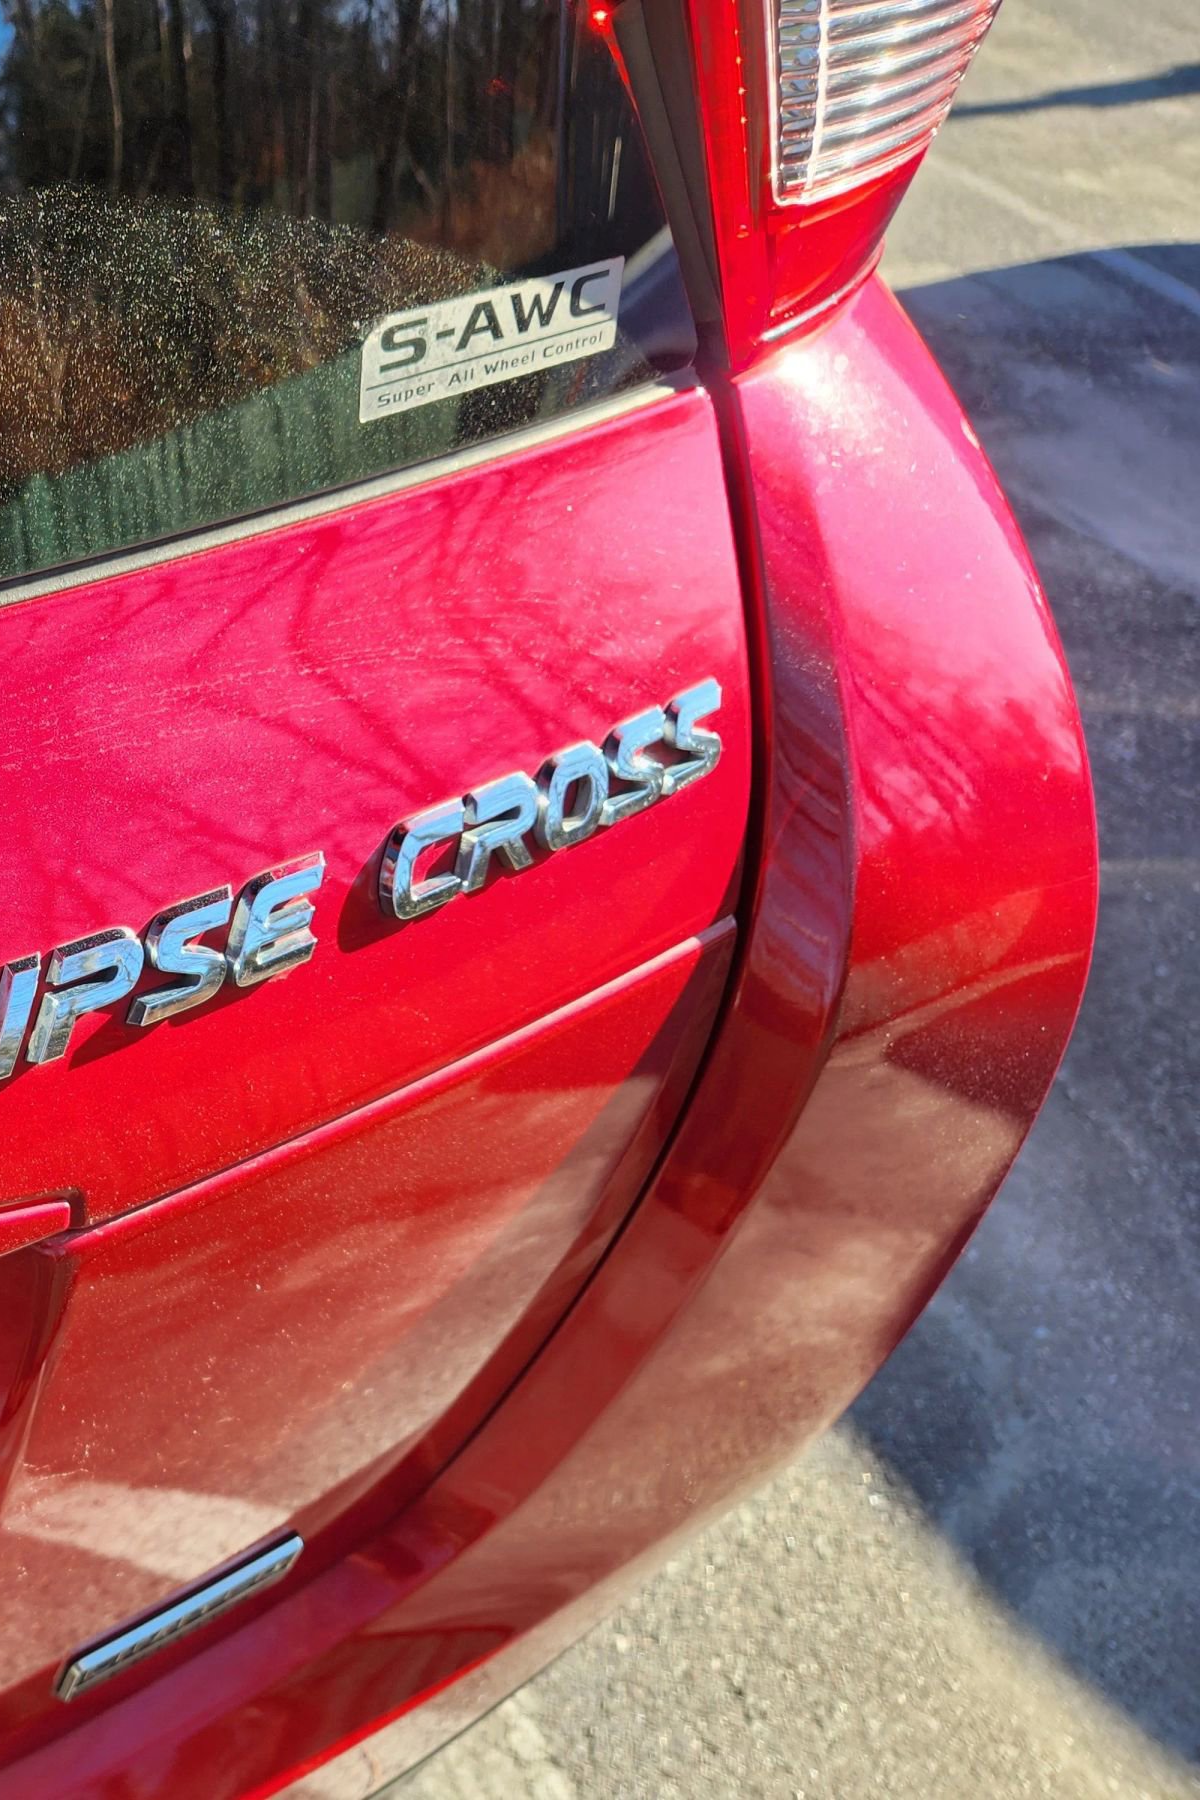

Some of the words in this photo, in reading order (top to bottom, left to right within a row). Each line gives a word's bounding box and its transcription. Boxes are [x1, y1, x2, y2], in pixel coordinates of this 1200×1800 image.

[376, 379, 436, 409] Super
[447, 369, 475, 388] All
[483, 349, 536, 376] Wheel
[542, 330, 603, 359] Control
[378, 269, 610, 375] S-AWC
[378, 676, 722, 920] CROSS
